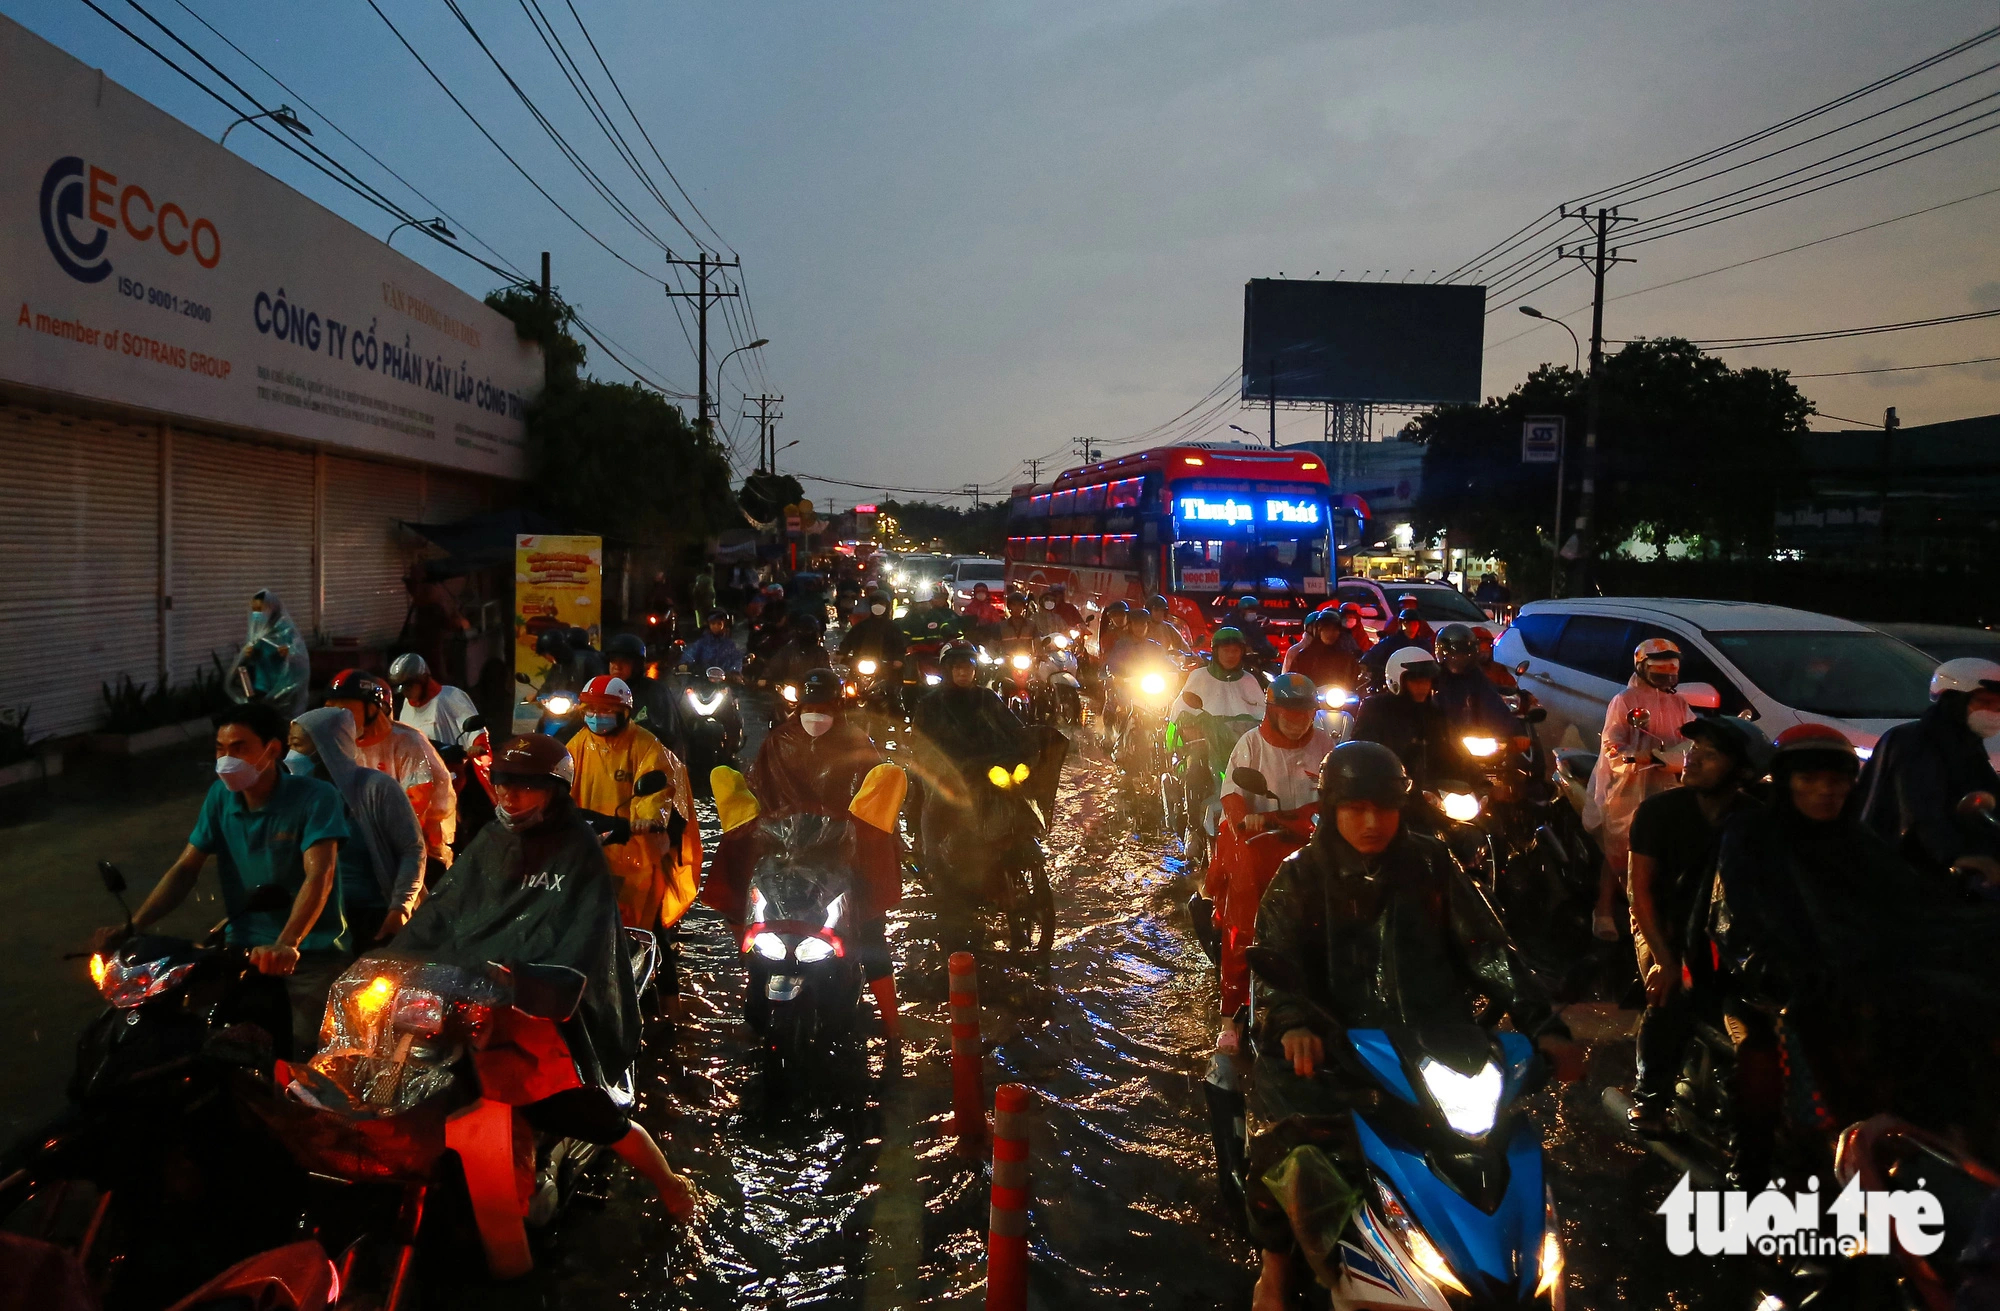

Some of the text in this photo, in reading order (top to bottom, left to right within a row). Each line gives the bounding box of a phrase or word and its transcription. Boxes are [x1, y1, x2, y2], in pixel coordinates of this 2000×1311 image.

[89, 165, 220, 269] ECCO
[118, 276, 212, 323] ISO 9001:2000
[18, 303, 231, 380] A member of SOTRANS GROUP
[254, 287, 321, 351] CÔNG
[327, 318, 347, 360] TY
[352, 316, 378, 370] CỔ
[382, 333, 422, 386] PHẦN
[425, 354, 451, 396] XÂY
[453, 360, 475, 404] LẮP
[476, 376, 507, 417] CÔNG
[1180, 498, 1319, 526] Thuận Phát
[1183, 572, 1204, 584] NGỌC
